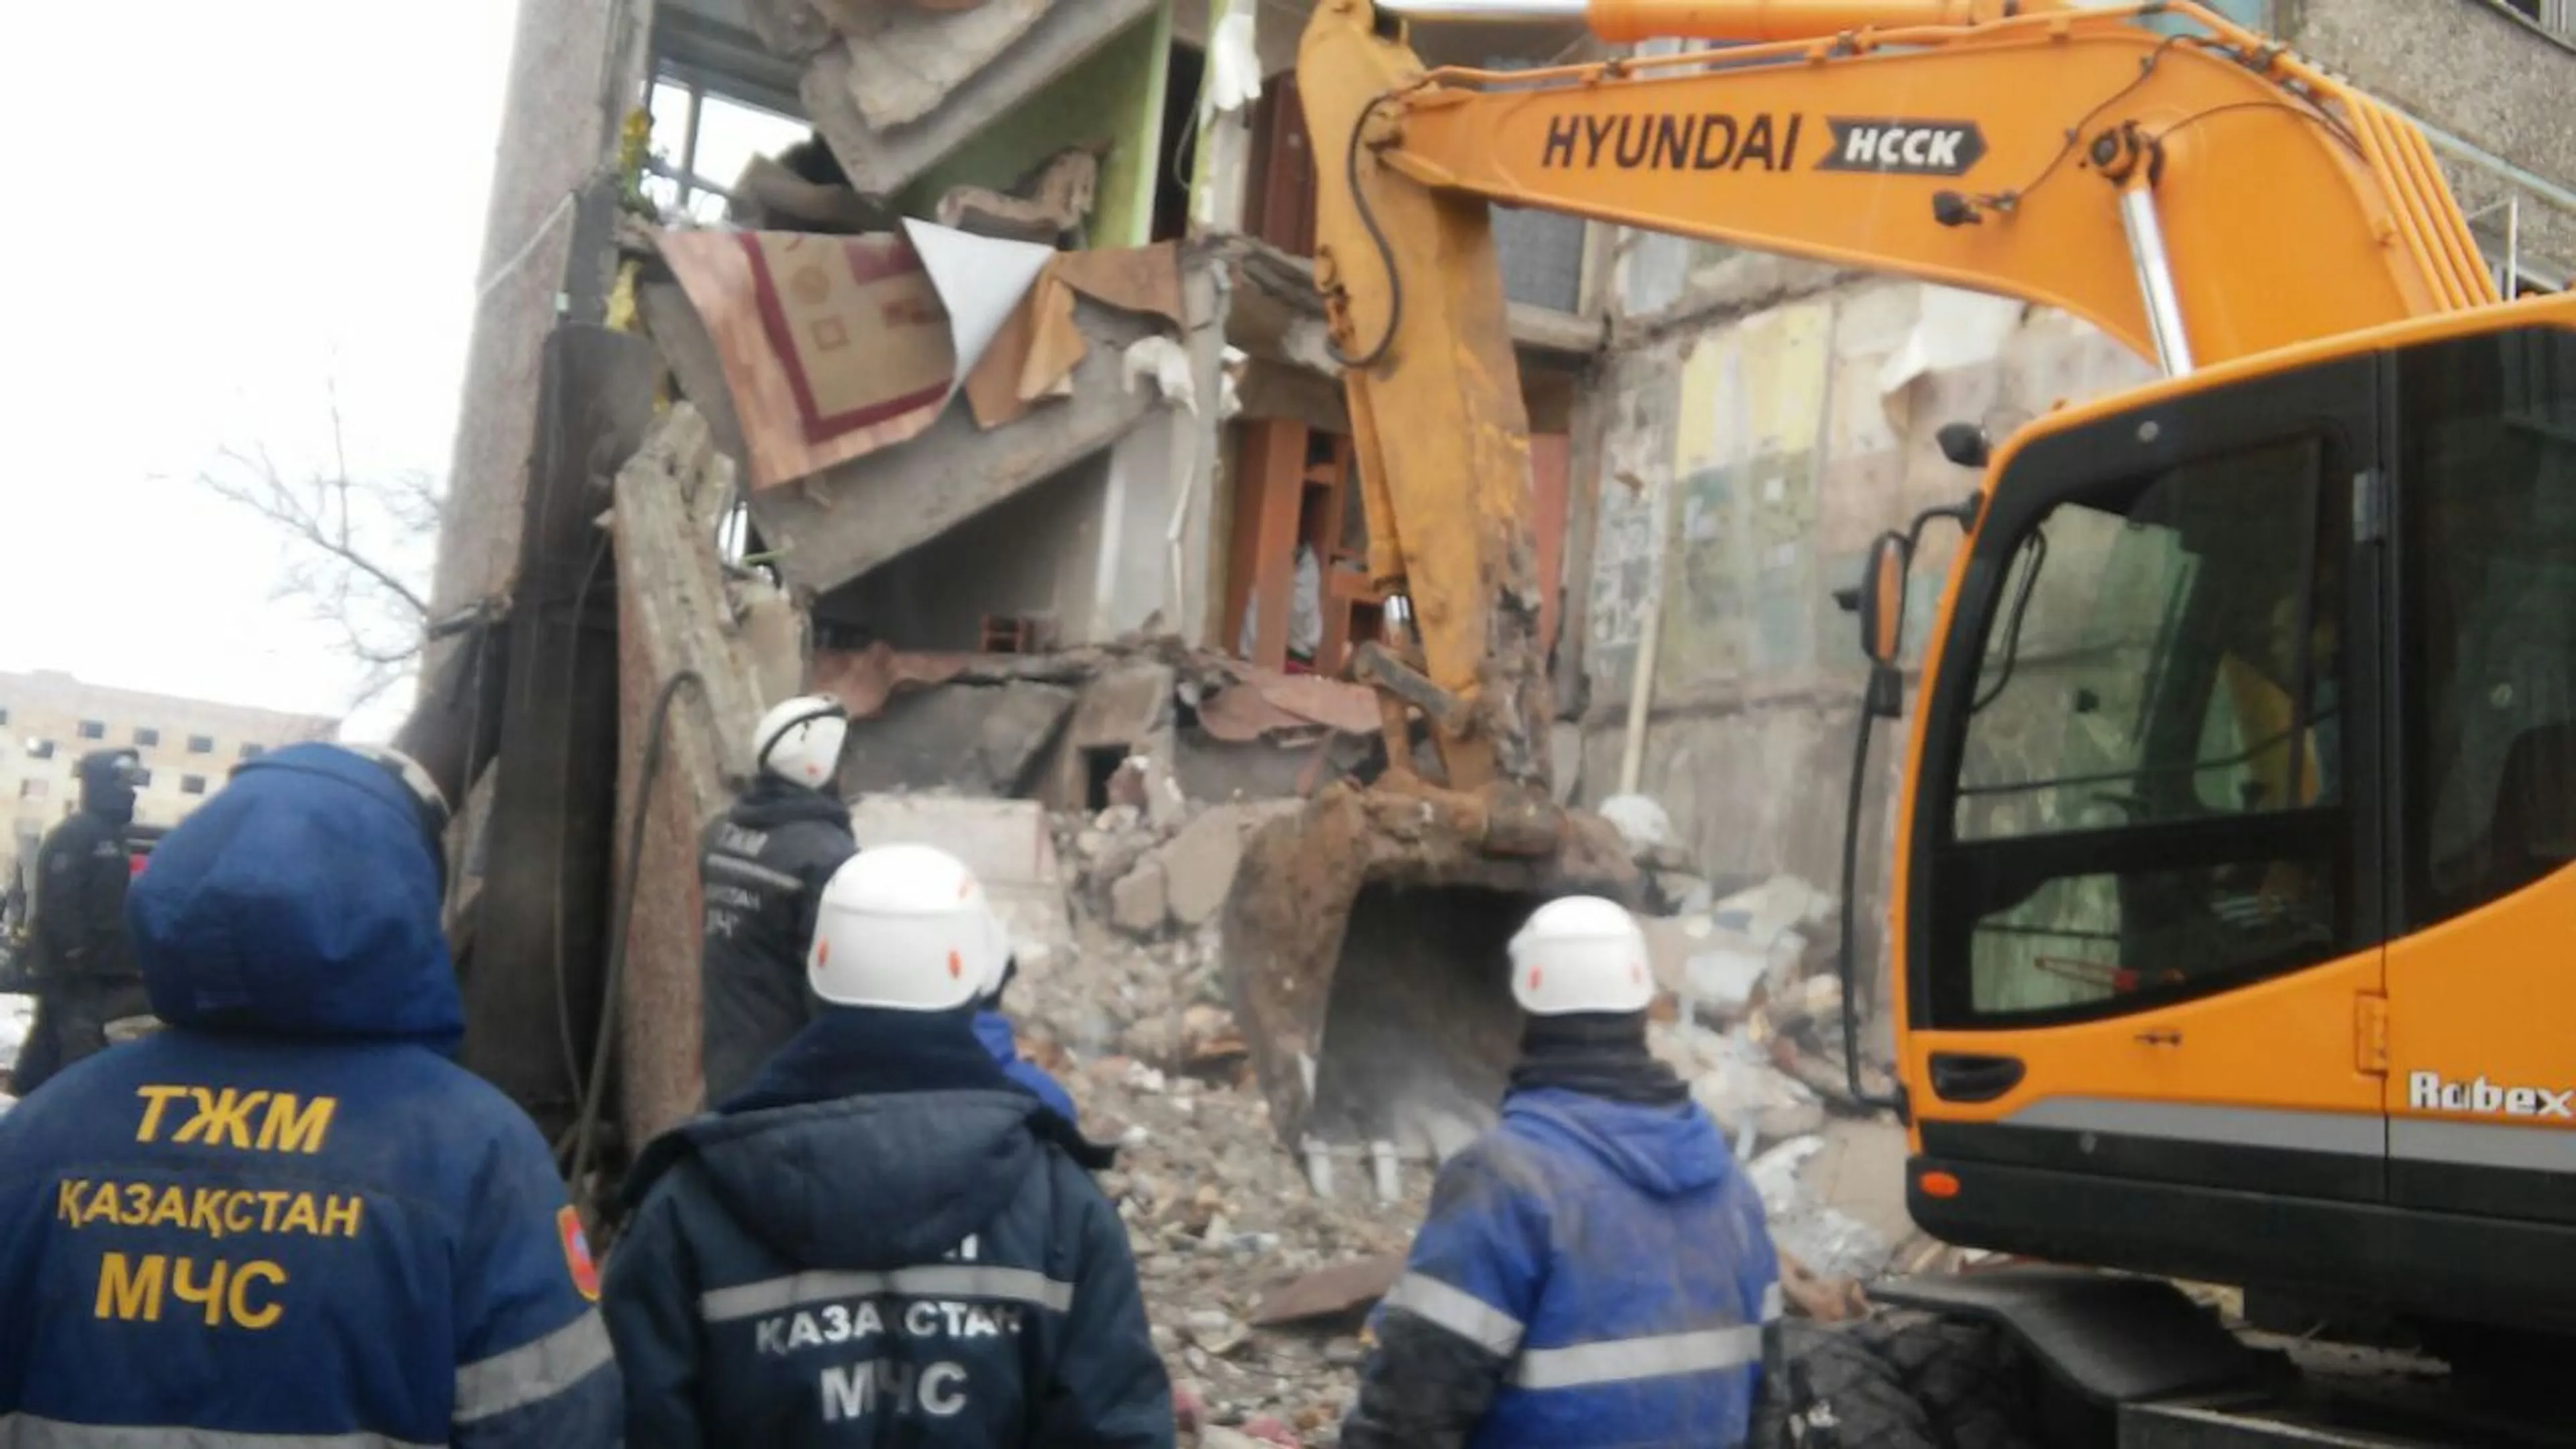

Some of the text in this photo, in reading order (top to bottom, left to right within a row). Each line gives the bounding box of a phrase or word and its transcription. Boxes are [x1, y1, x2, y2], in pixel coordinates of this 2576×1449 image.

[1542, 112, 1963, 172] HYUNDAI HCCK
[136, 1085, 337, 1153] ТЖМ
[57, 1179, 363, 1238] ҚАЗАҚСТАН
[94, 1252, 288, 1330] МЧС
[820, 1360, 968, 1421] МЧС
